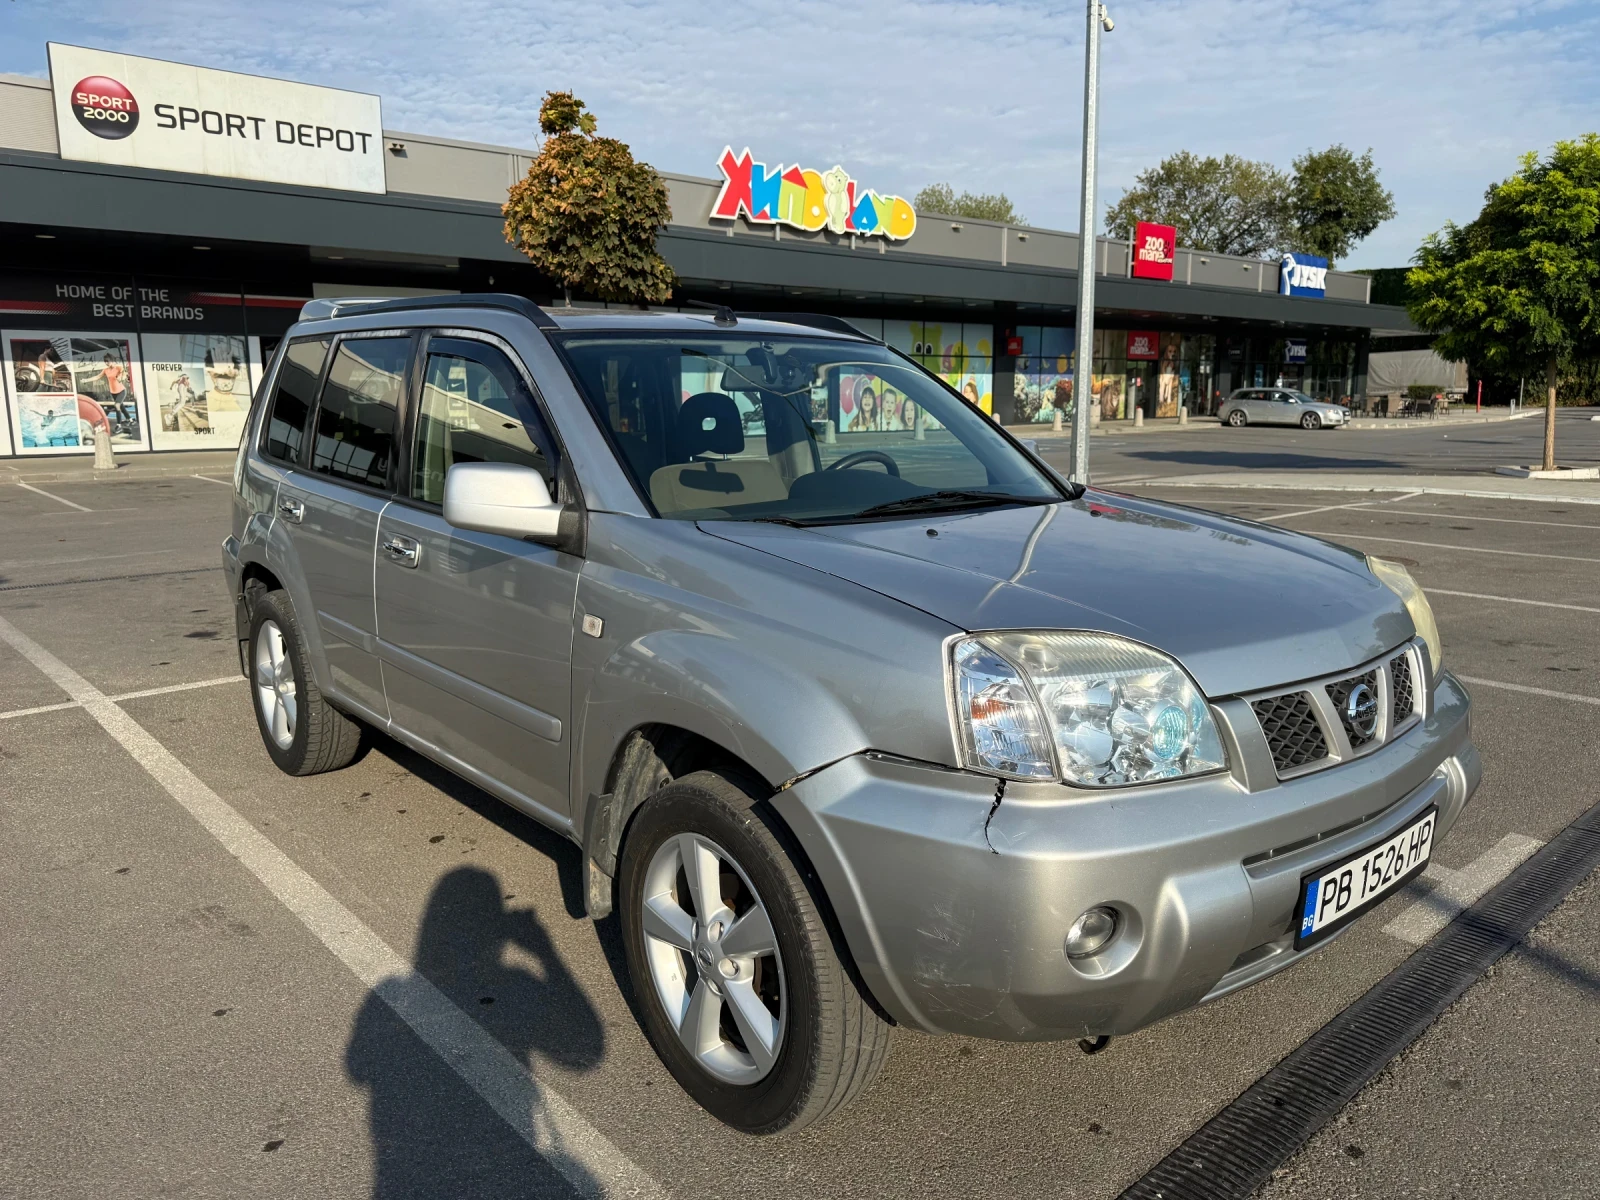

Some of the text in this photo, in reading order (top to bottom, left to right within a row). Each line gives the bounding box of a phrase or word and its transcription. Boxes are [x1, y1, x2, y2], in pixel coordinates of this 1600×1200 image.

[76, 92, 133, 110] SPORT
[83, 106, 129, 123] 2000
[154, 103, 372, 154] SPORT DEPOT
[1290, 264, 1327, 290] JYSK
[56, 284, 170, 302] HOME OF THE
[93, 303, 204, 320] BEST BRANDS
[1290, 345, 1306, 356] JYSK
[152, 363, 183, 372] FOREVER
[194, 427, 215, 435] SPORT
[1319, 819, 1432, 923] PB 1526 HP
[1302, 914, 1314, 930] BG
